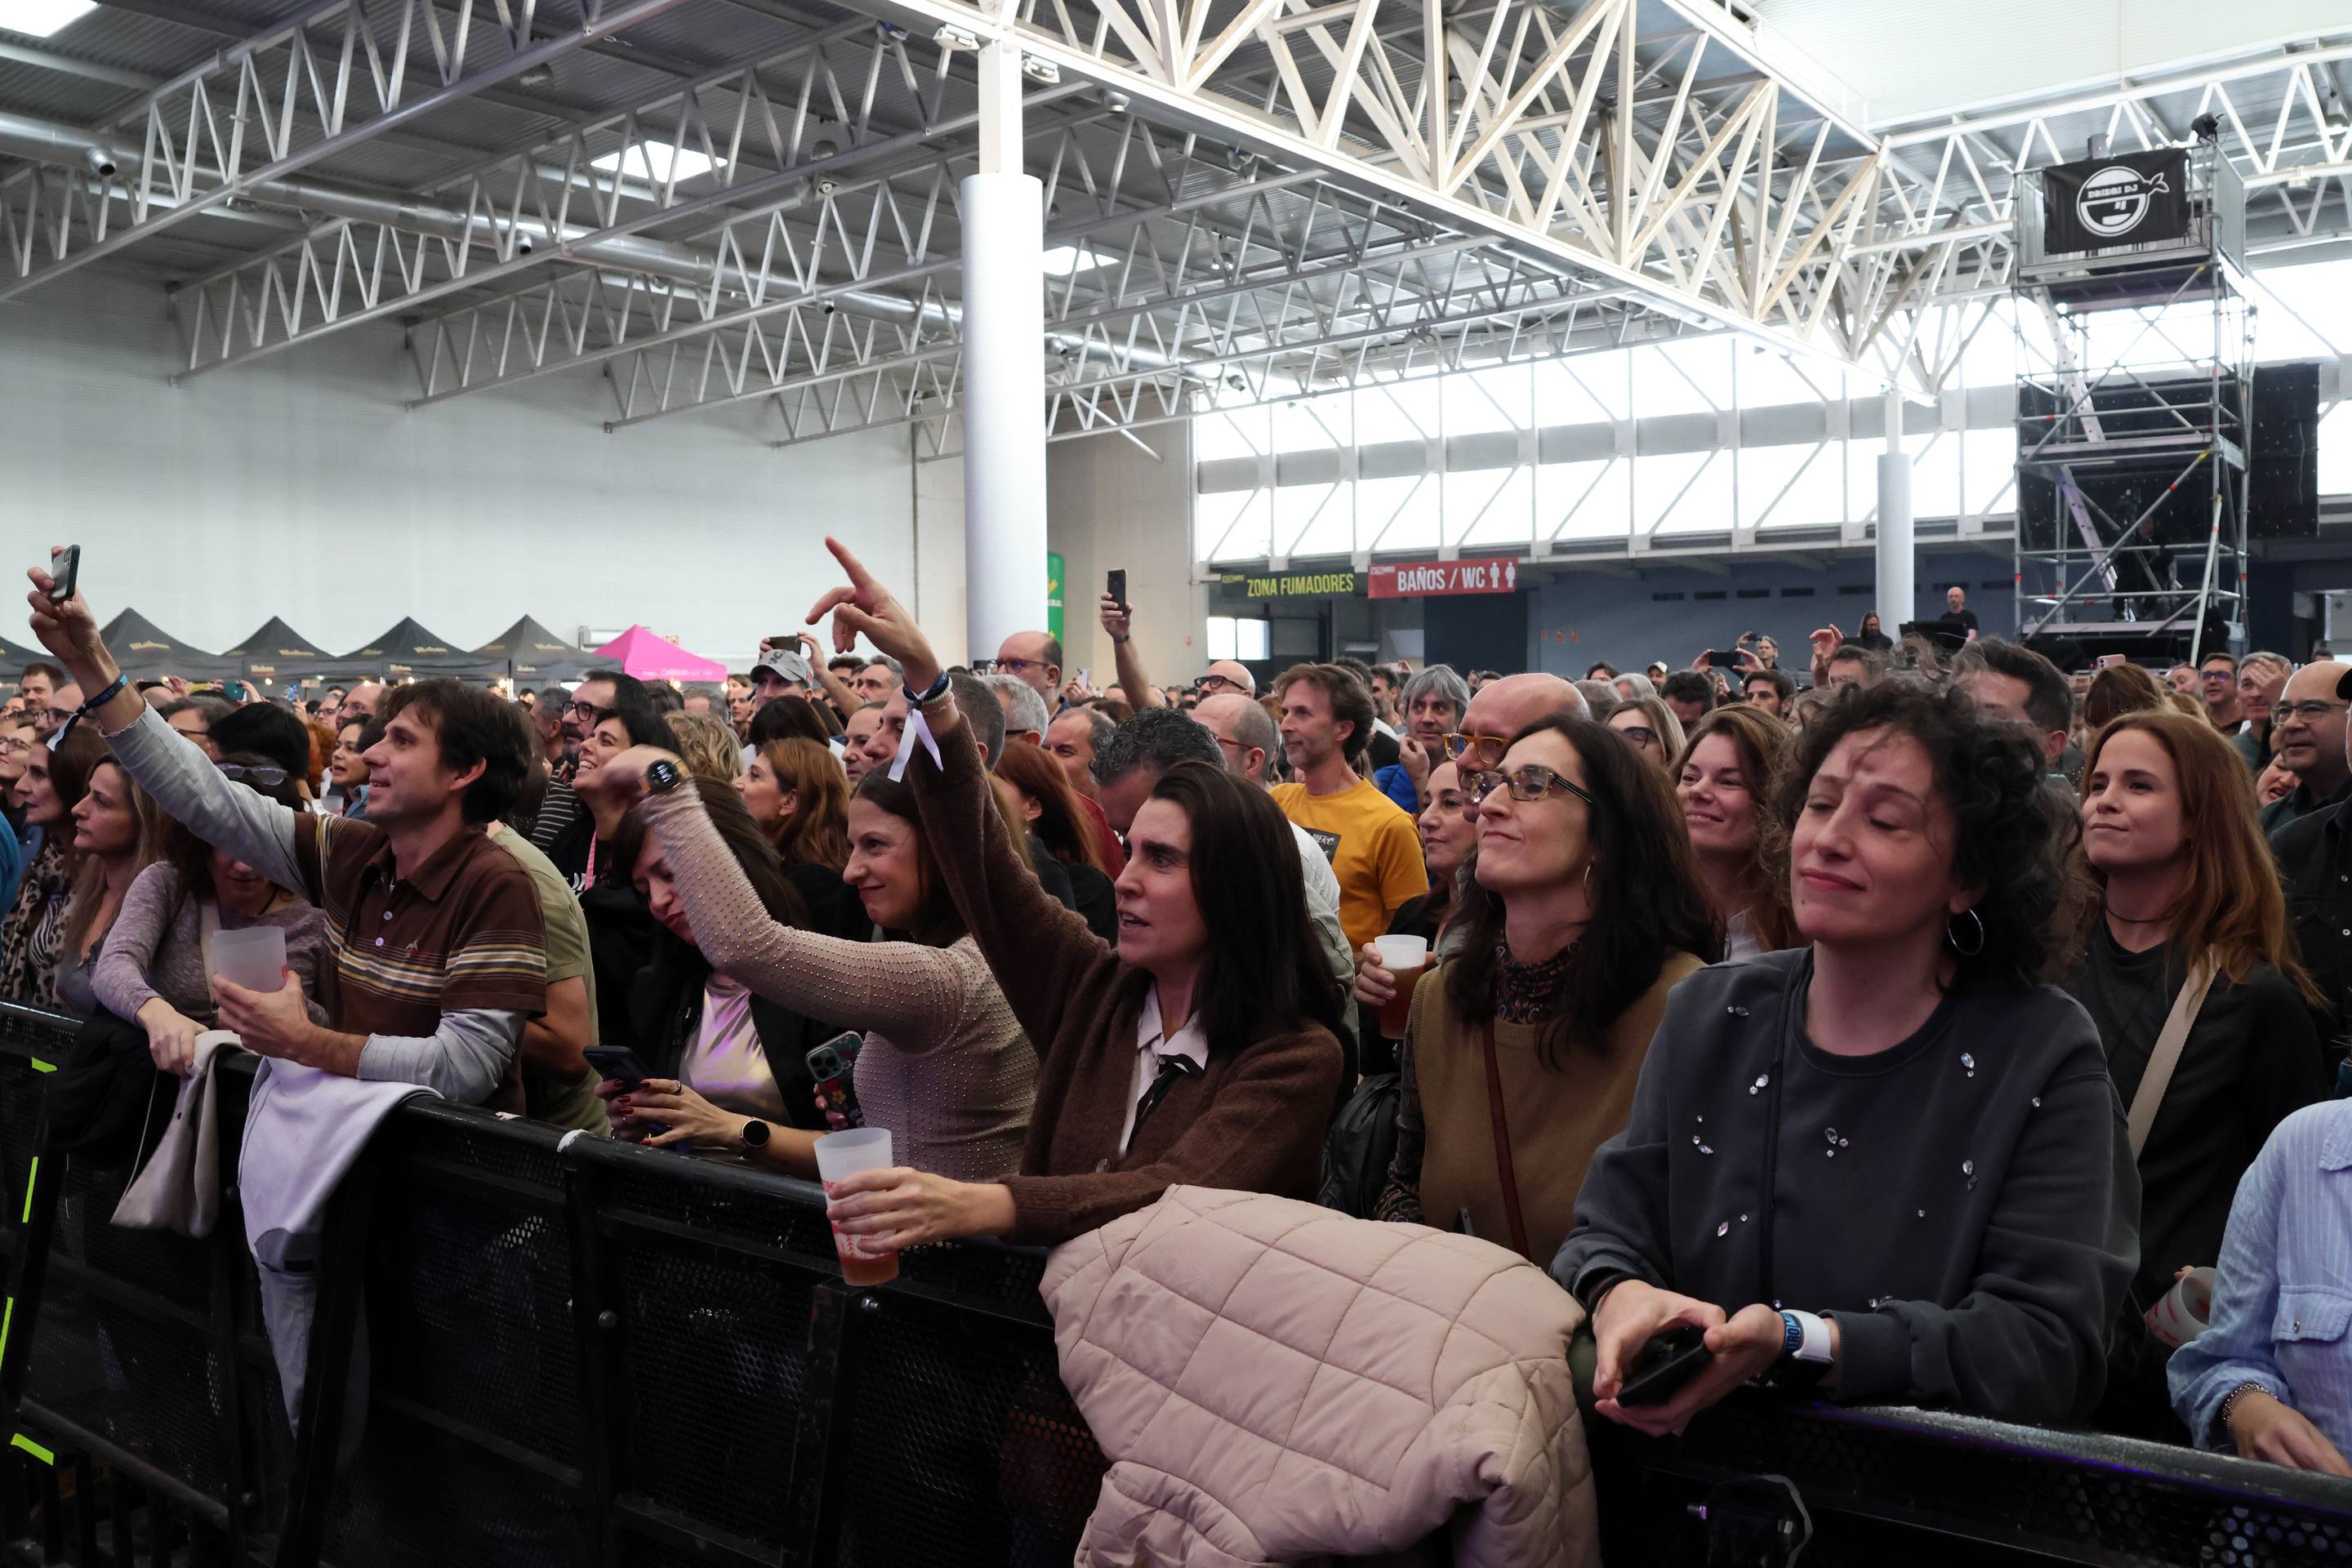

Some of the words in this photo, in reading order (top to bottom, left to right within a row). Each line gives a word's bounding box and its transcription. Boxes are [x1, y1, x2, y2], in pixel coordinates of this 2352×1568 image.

[2124, 184, 2138, 194] DJ
[1247, 578, 1277, 597] ZONA
[1281, 573, 1354, 595] FUMADORES
[1397, 566, 1446, 592] BAÑOS
[1462, 566, 1486, 589] WC
